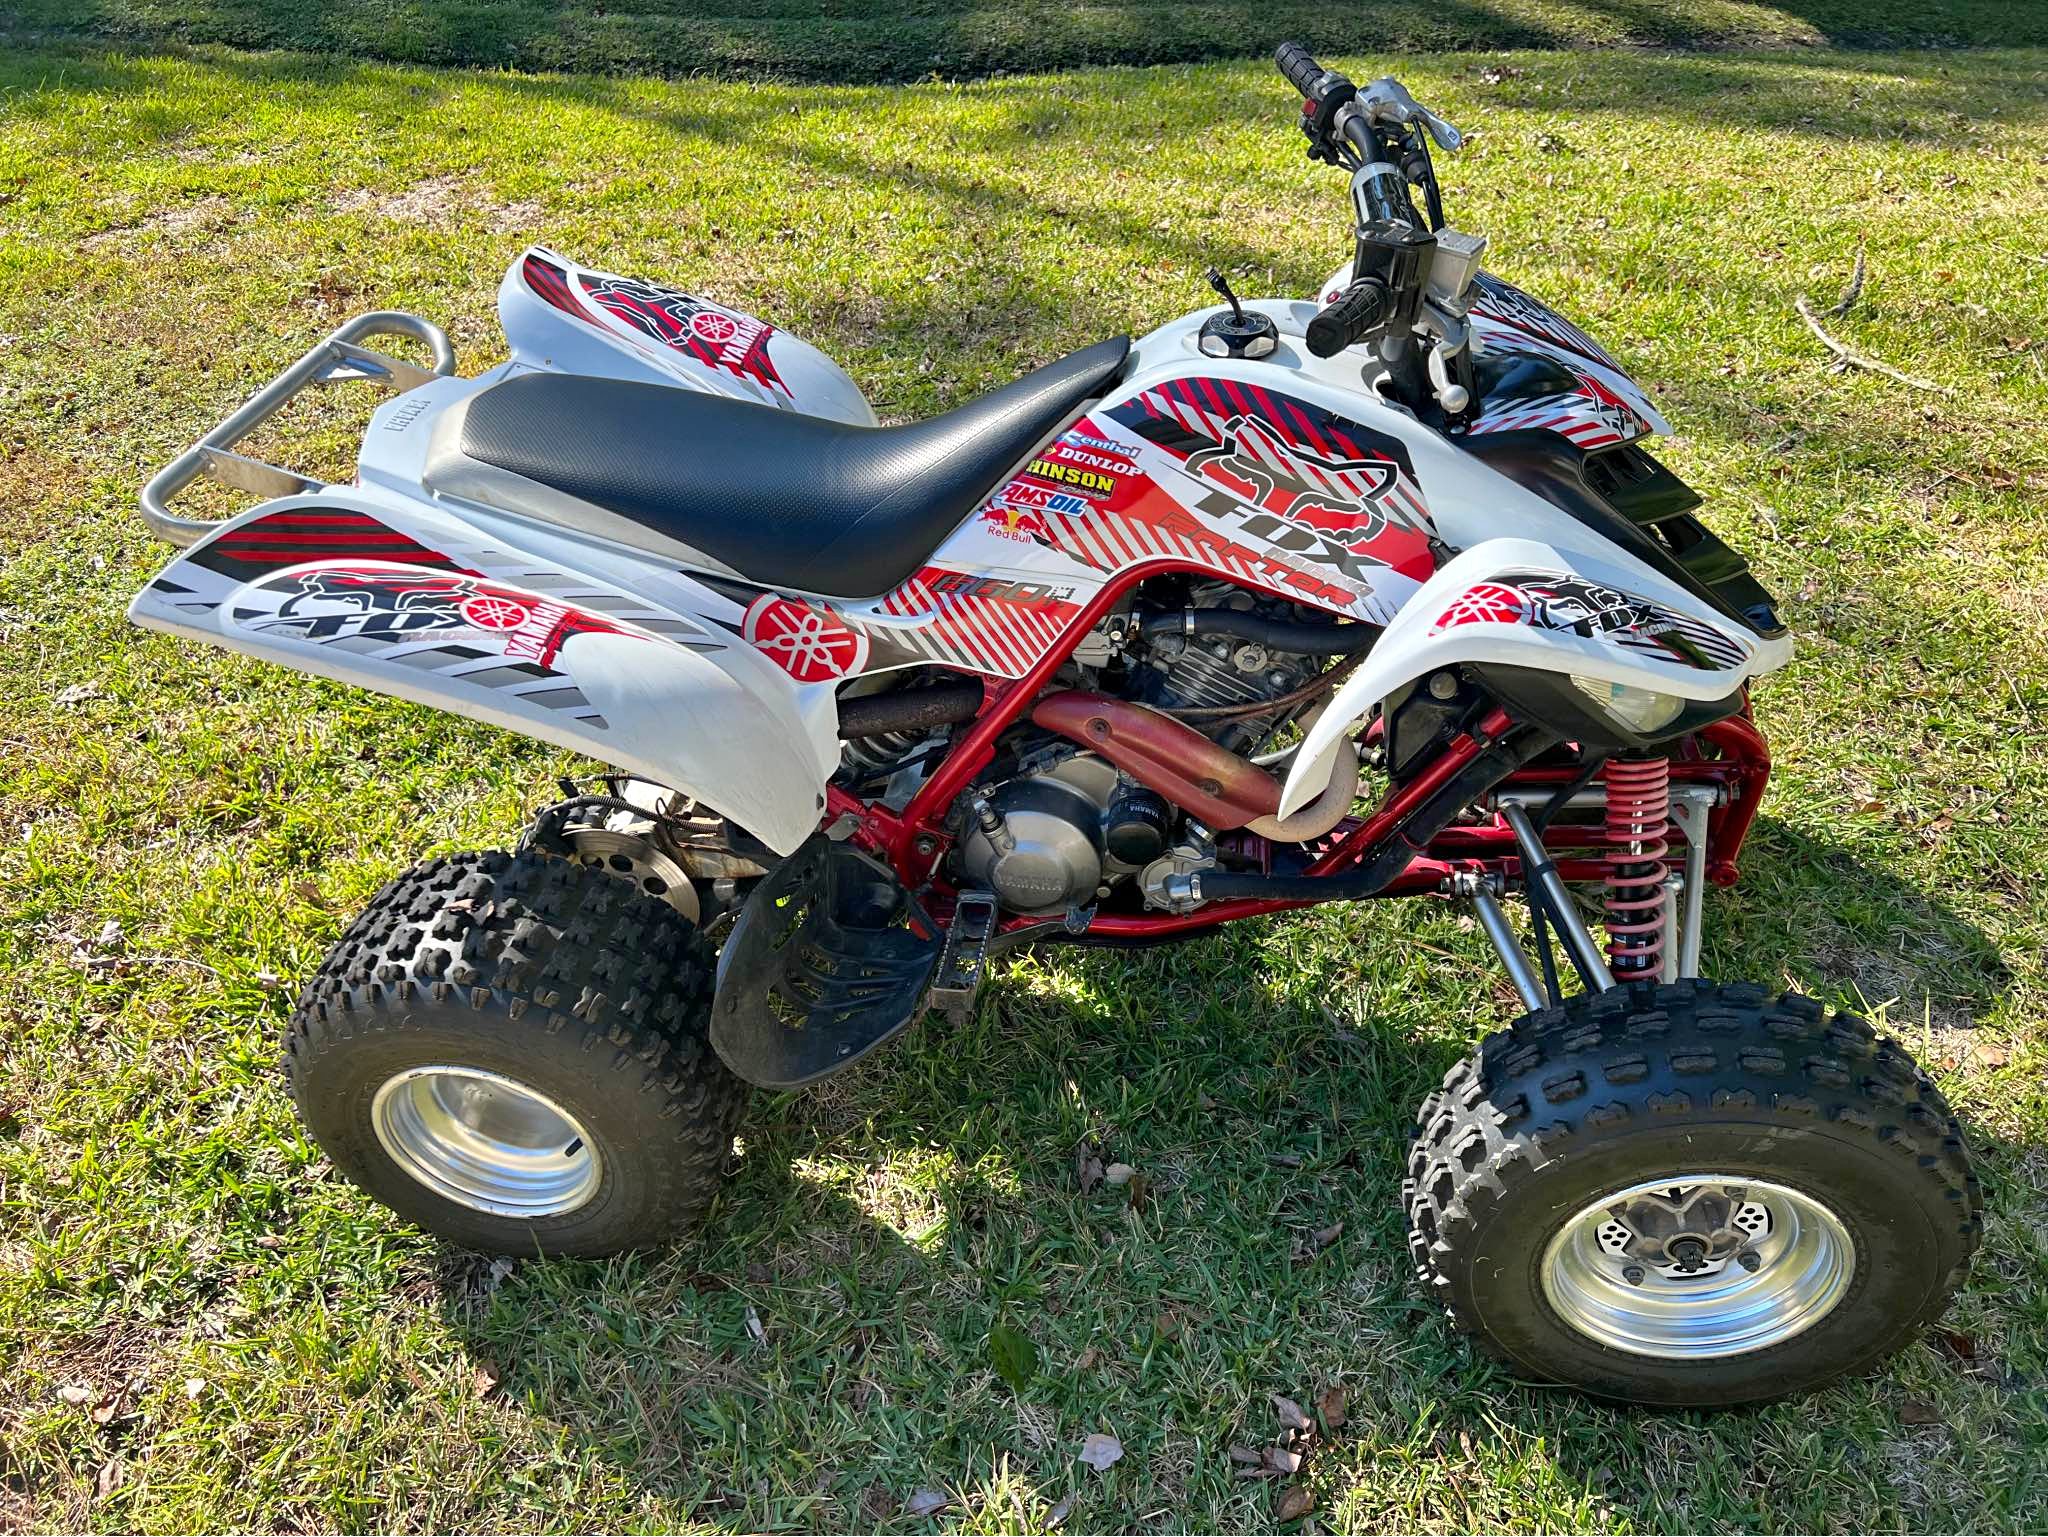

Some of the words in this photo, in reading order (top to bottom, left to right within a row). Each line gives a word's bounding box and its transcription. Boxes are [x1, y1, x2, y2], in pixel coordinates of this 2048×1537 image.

[1026, 459, 1116, 492] HINSON
[1058, 447, 1145, 477] DUNLOP
[999, 484, 1088, 516] AMSOIL
[988, 525, 1009, 540] Red
[1011, 530, 1032, 544] Bull
[1160, 461, 1393, 585] FOX
[1158, 511, 1358, 608] RAPTOR
[504, 602, 570, 660] YAMAHA
[1555, 604, 1666, 638] FOX
